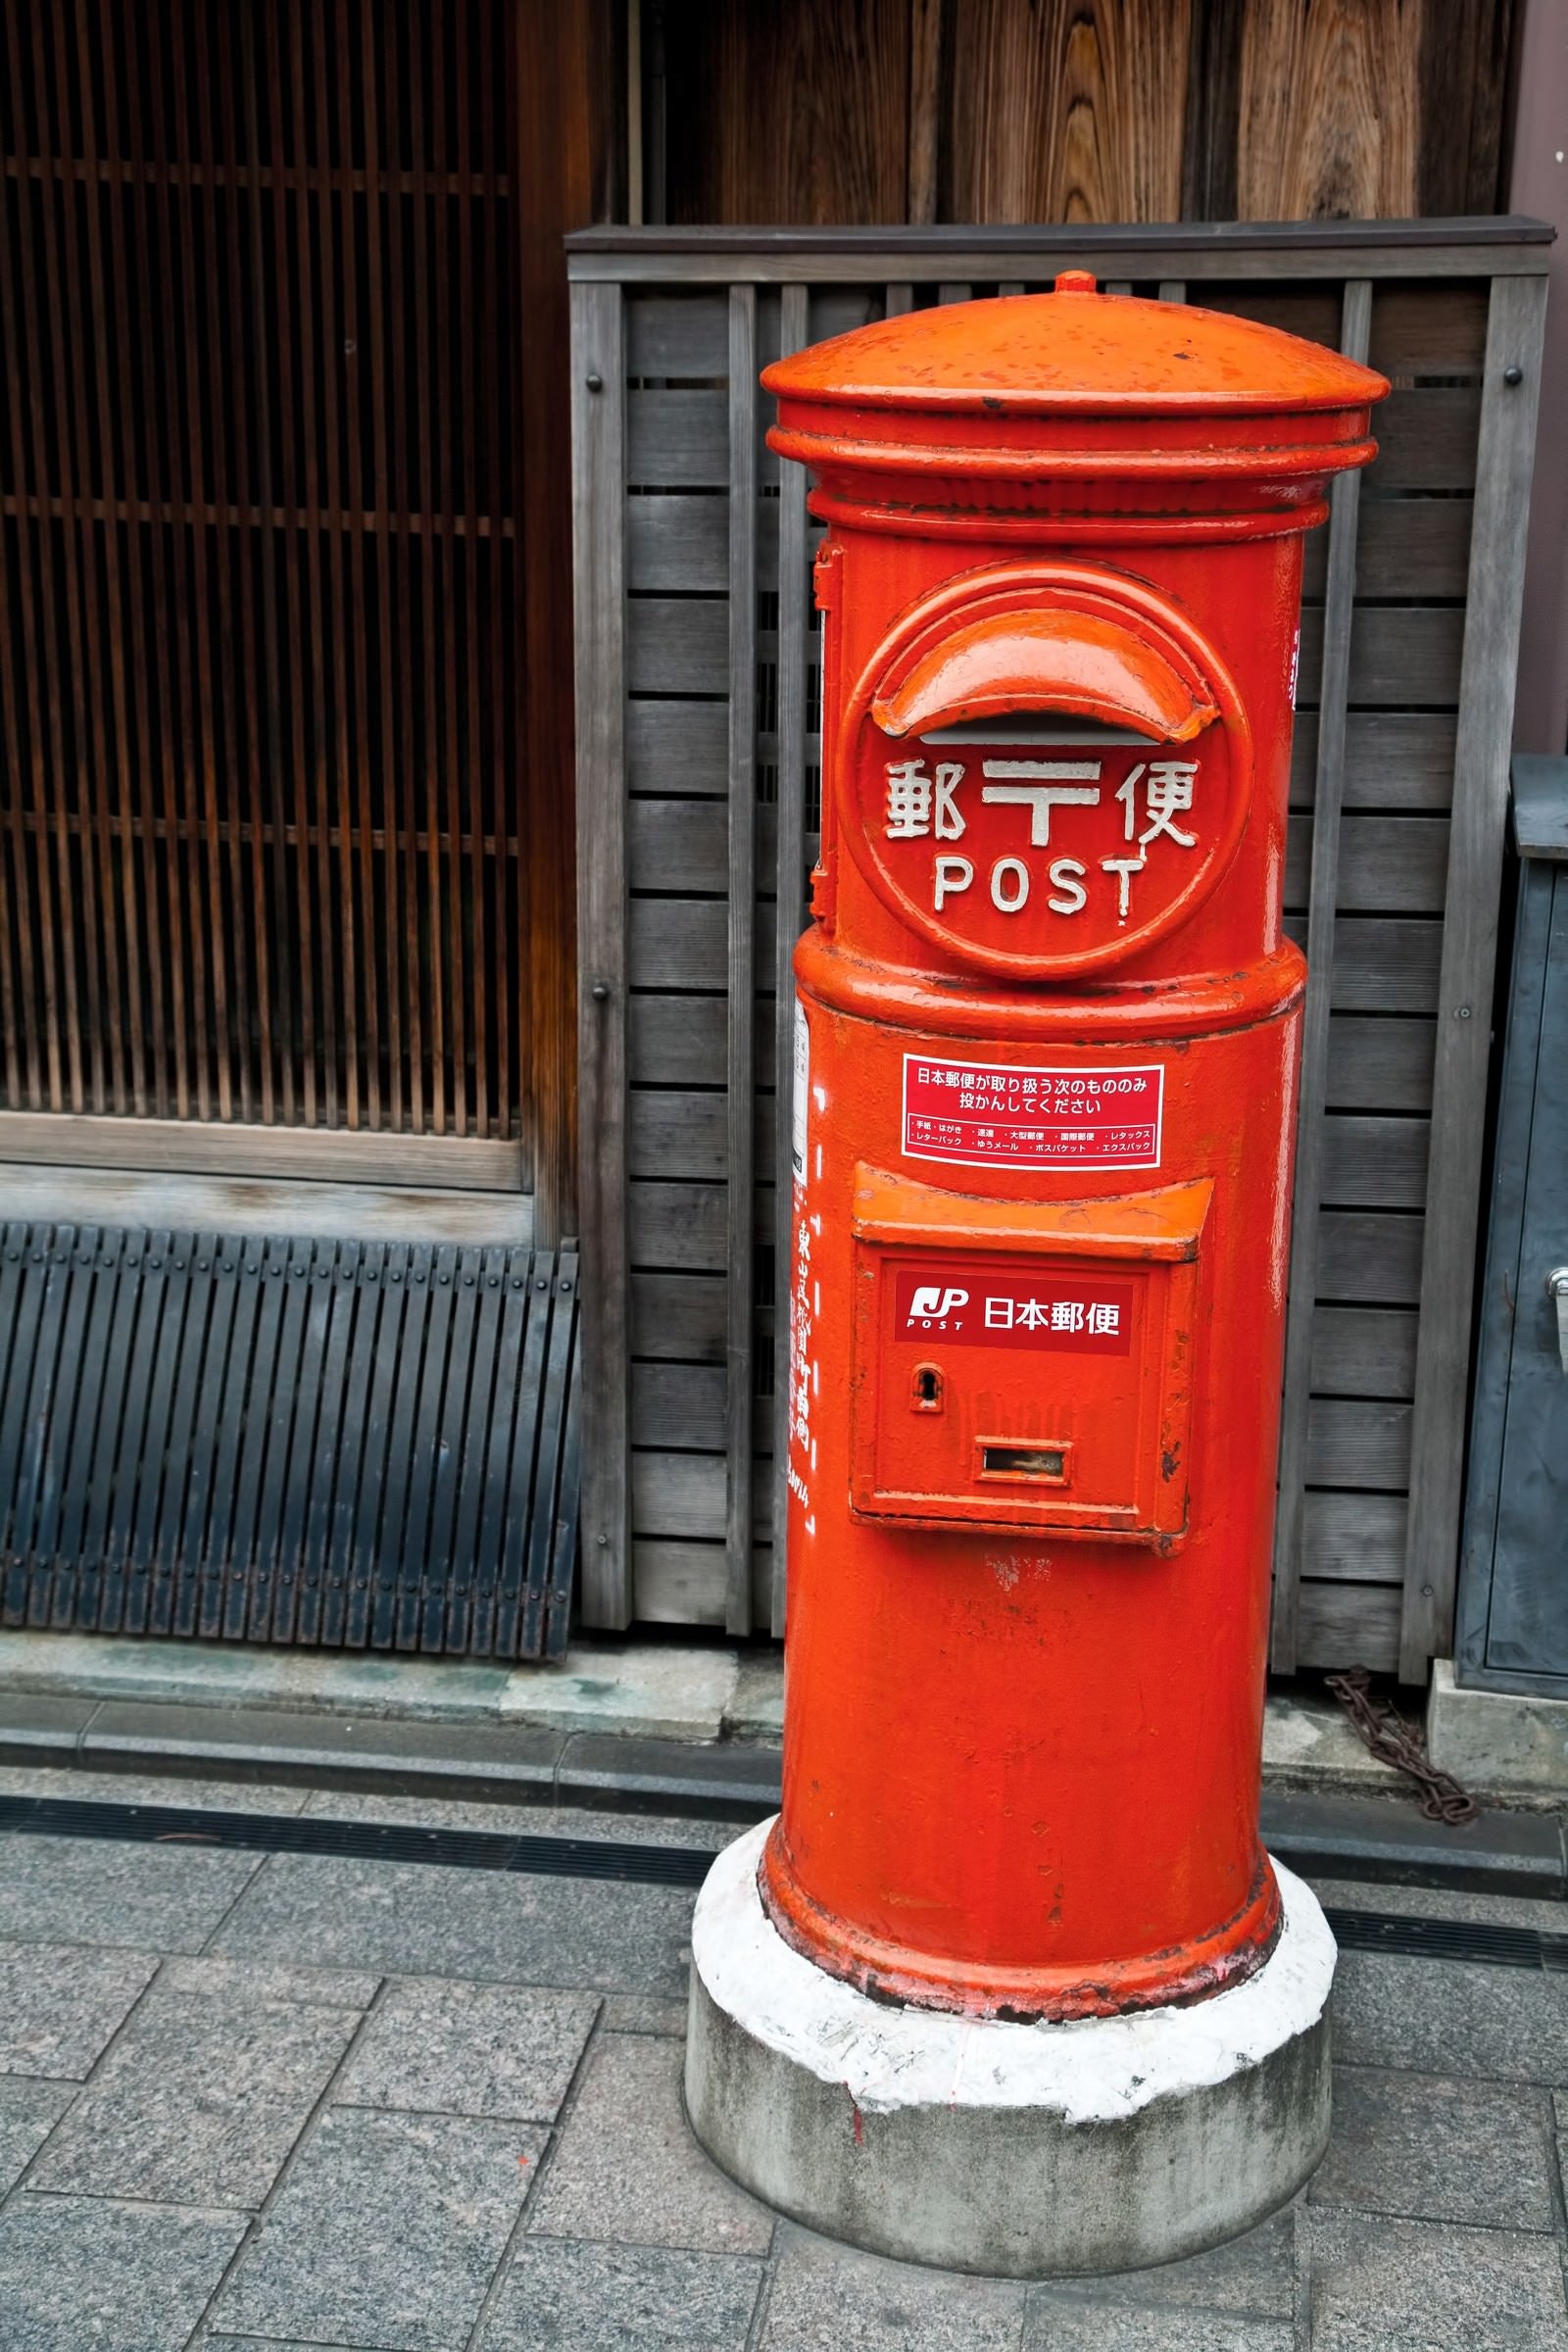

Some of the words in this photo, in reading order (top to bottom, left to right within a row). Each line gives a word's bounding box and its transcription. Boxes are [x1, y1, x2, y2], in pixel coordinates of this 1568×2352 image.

[934, 856, 1144, 917] POST
[917, 1067, 1148, 1096] 日本郵便が取り扱う次のもののみ
[959, 1092, 1102, 1114] 投かんしてください
[906, 1318, 963, 1331] POST
[984, 1297, 1120, 1336] 日本郵便
